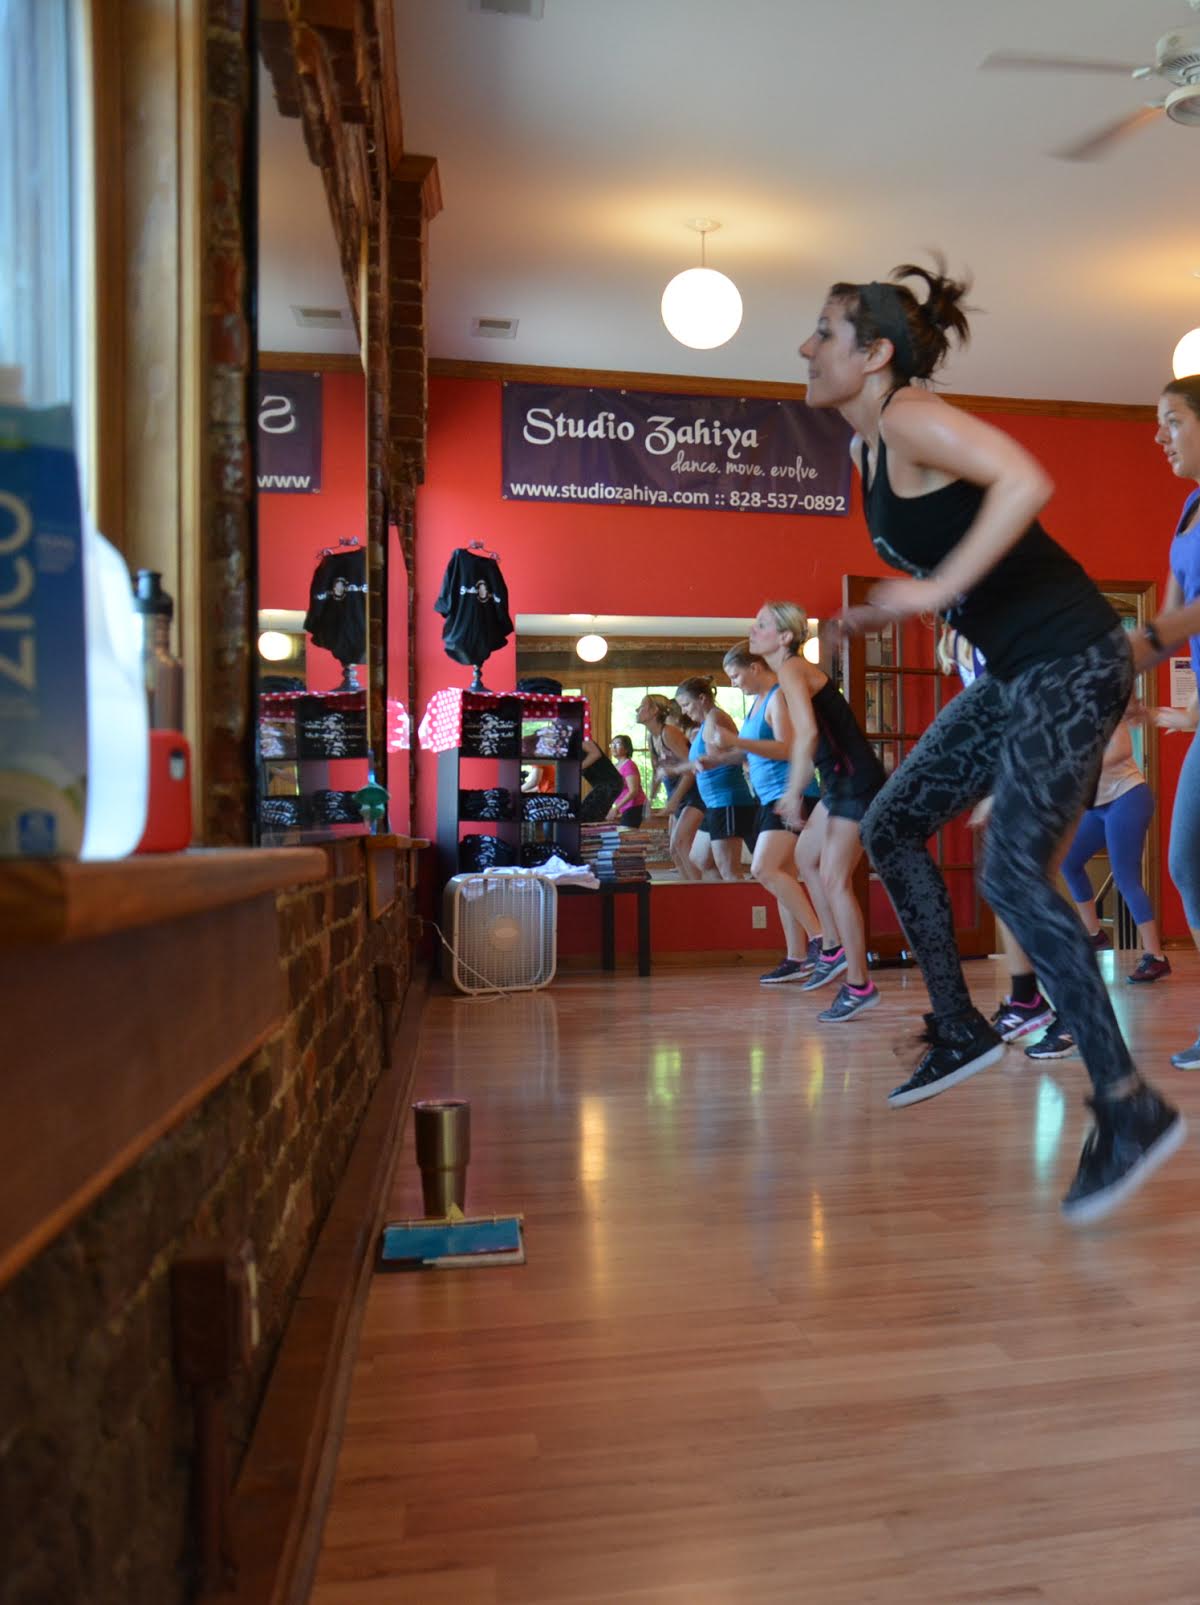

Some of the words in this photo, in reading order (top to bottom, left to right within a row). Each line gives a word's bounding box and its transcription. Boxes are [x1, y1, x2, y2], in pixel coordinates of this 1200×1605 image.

[523, 408, 635, 445] Studio
[645, 415, 759, 459] Zahiya
[670, 450, 721, 474] dance.
[726, 461, 766, 477] move.
[770, 455, 818, 482] evolve
[510, 482, 710, 505] www.studiozahiya.com
[730, 490, 846, 511] 828-537-0892
